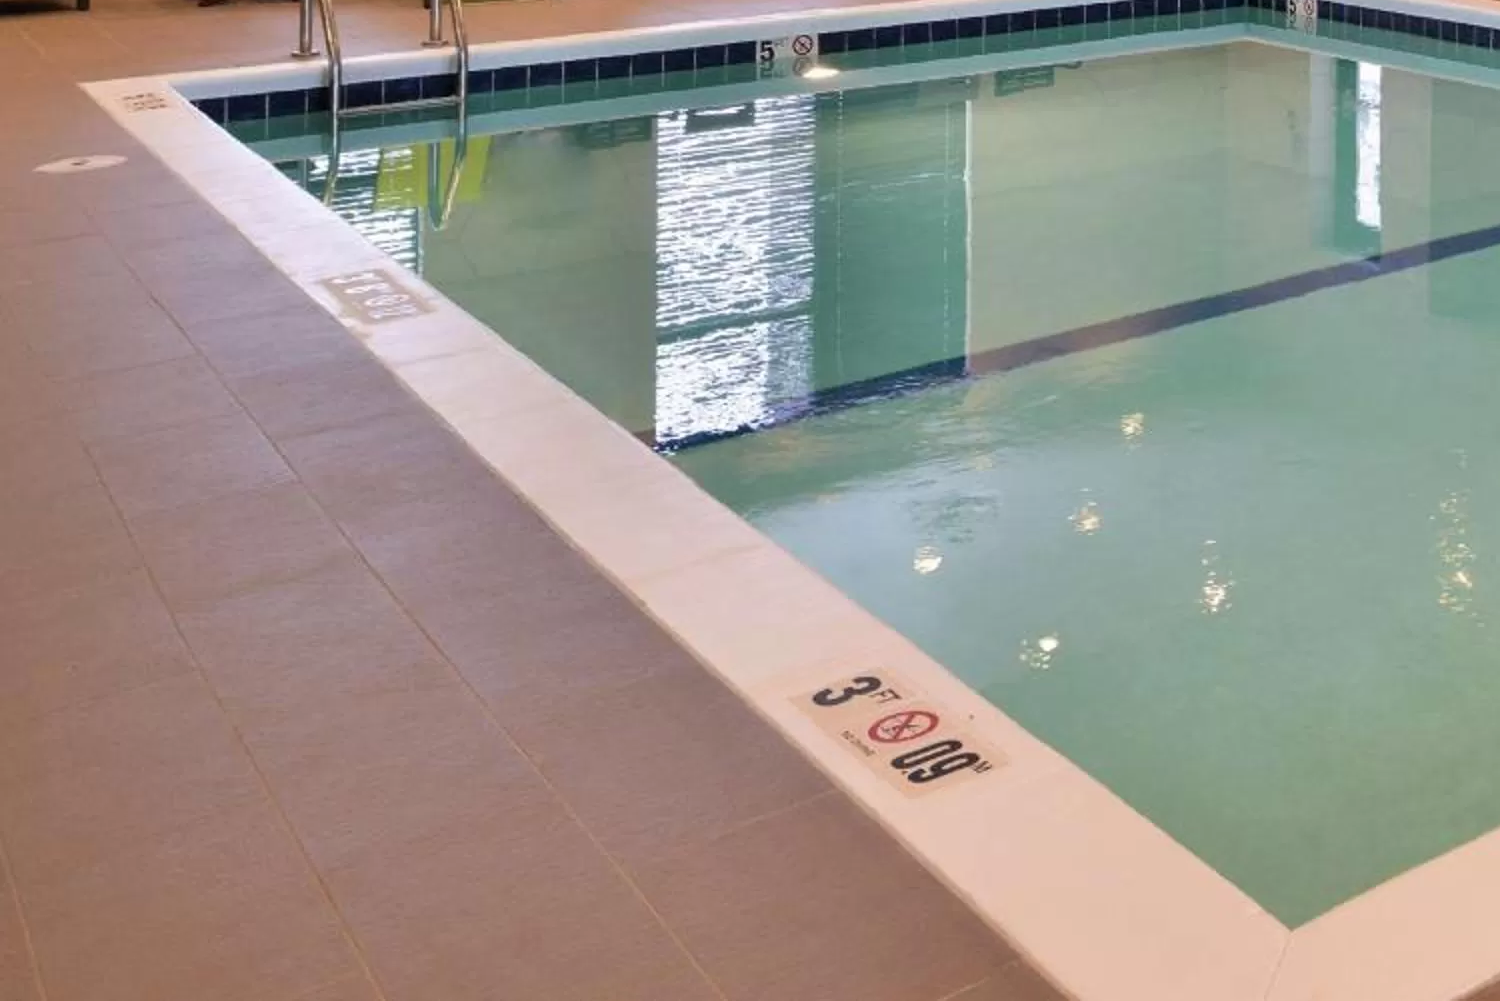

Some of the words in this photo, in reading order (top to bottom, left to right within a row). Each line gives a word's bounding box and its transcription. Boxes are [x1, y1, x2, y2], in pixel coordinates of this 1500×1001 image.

[760, 40, 775, 60] 5
[812, 676, 882, 706] 3
[871, 688, 902, 704] FT
